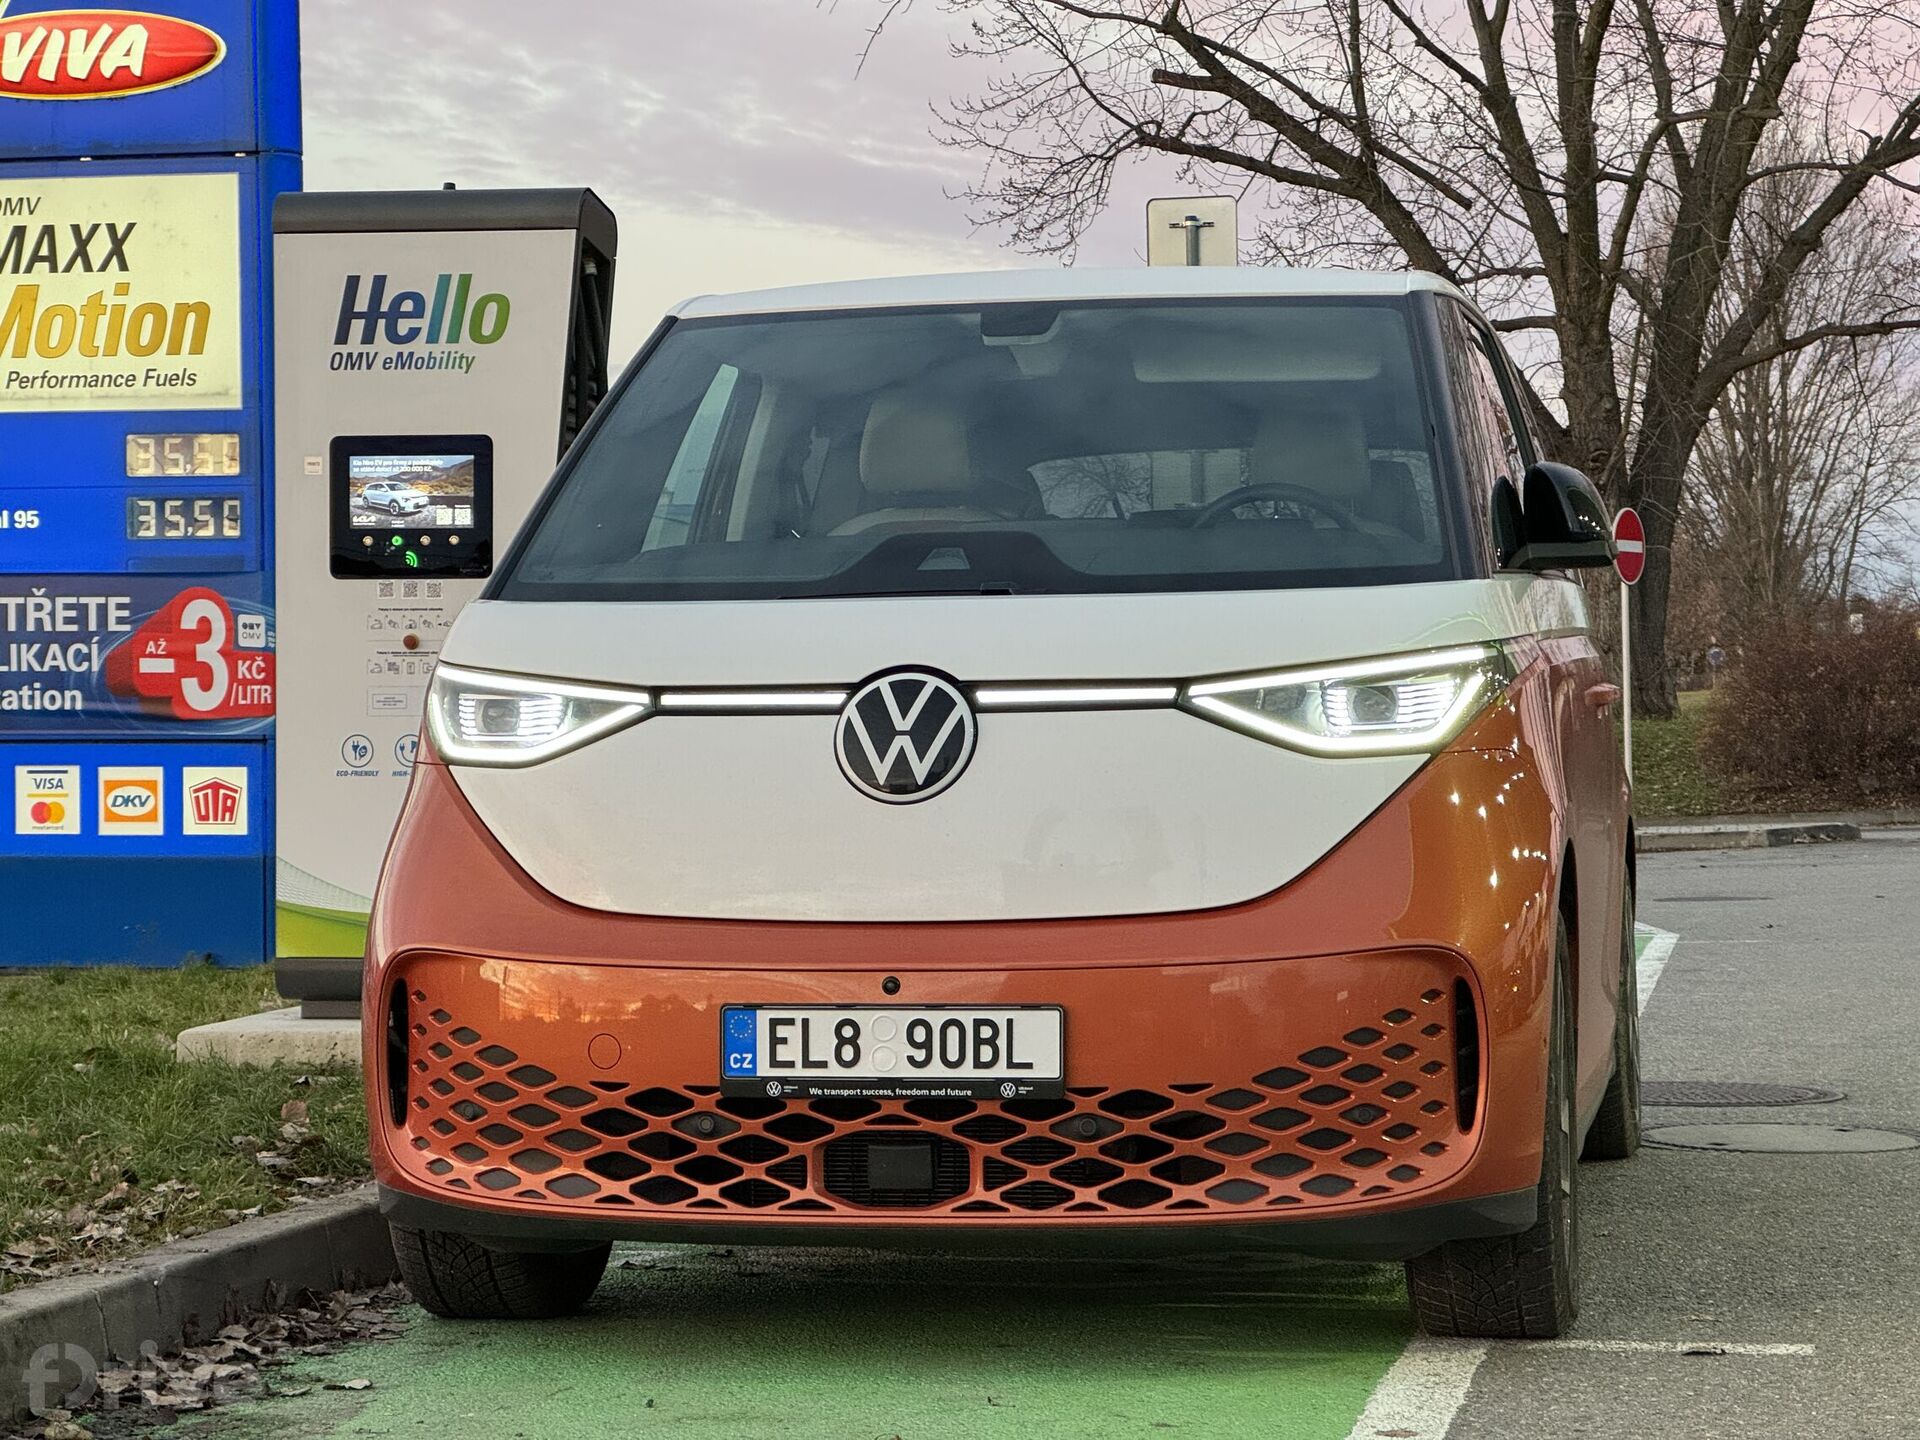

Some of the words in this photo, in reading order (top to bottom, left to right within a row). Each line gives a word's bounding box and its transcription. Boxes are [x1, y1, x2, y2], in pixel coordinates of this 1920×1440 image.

[1, 23, 149, 83] VIVA
[0, 196, 42, 216] MV
[334, 273, 511, 345] Hello
[329, 351, 379, 371] OMV
[382, 350, 476, 374] eMobility
[6, 369, 137, 390] Performance
[142, 367, 198, 388] Fuels
[14, 510, 40, 529] 95
[145, 638, 168, 655] AŽ
[237, 655, 267, 680] KČ
[0, 682, 83, 711] ation
[229, 682, 273, 707] /LITR
[32, 778, 64, 790] VISA
[111, 794, 152, 808] DKV
[192, 780, 240, 822] UTA
[768, 1017, 861, 1070] EL8
[905, 1017, 1034, 1070] 90BL
[729, 1053, 753, 1069] CZ
[809, 1087, 822, 1096] We
[824, 1087, 861, 1098] transport
[862, 1088, 894, 1097] success,
[895, 1087, 929, 1096] freedom
[930, 1087, 946, 1096] and
[946, 1087, 972, 1096] future
